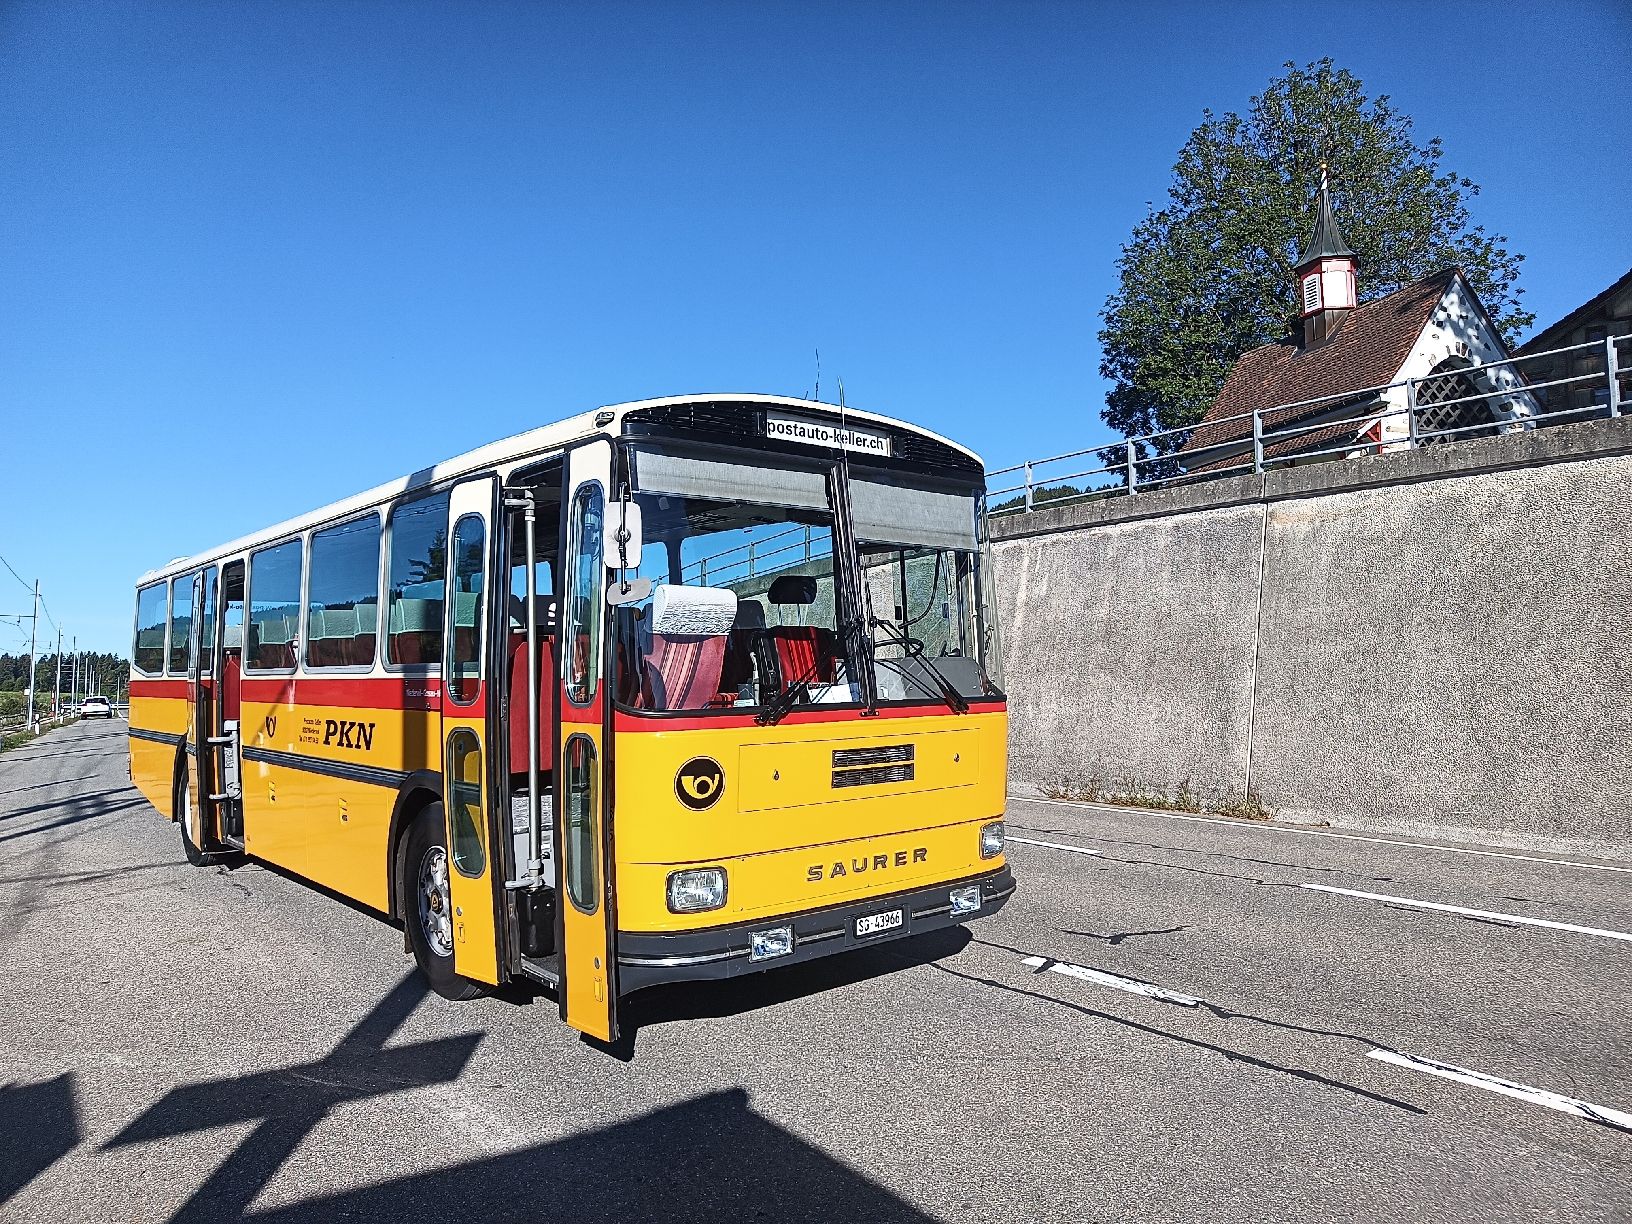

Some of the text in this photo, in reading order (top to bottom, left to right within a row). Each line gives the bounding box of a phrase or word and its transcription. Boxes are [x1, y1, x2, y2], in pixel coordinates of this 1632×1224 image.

[767, 421, 884, 450] postauto-keller.ch
[323, 720, 376, 750] PKN
[807, 847, 928, 881] SAURER
